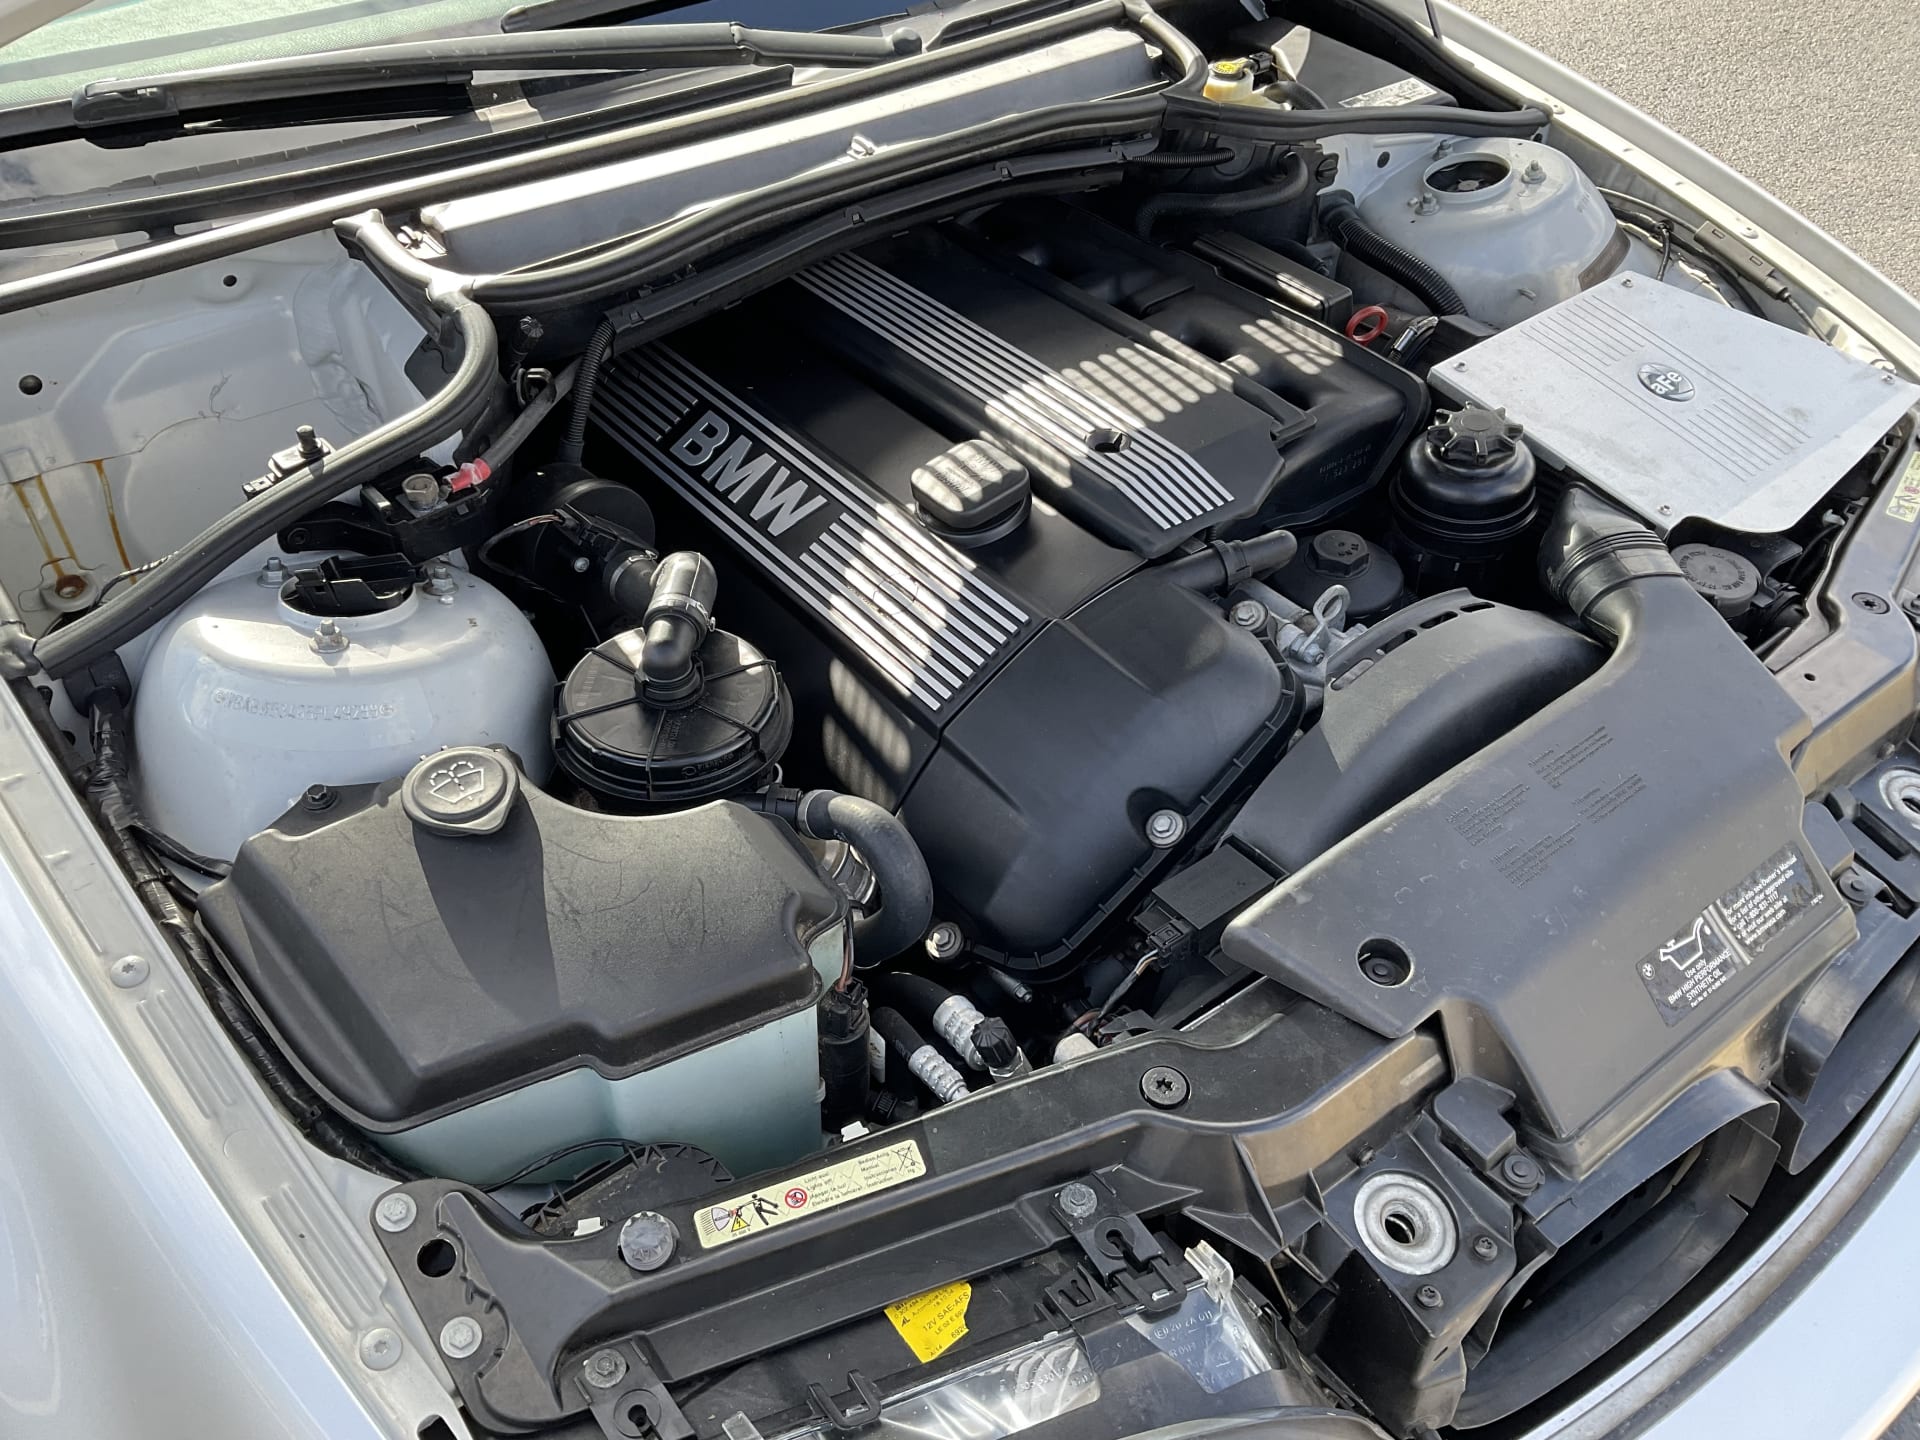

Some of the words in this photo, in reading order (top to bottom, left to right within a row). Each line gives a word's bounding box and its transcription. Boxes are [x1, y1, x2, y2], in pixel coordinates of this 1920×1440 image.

[1650, 371, 1683, 395] aFe
[669, 409, 828, 537] BMW
[1744, 890, 1755, 900] info
[1761, 869, 1781, 886] Owner's
[1779, 854, 1797, 871] Manual
[1764, 874, 1786, 896] approved
[1784, 869, 1794, 879] oils
[1668, 987, 1682, 1004] BMW
[1681, 977, 1696, 994] HIGH
[1694, 947, 1732, 983] PERFORMANCE
[1684, 966, 1696, 978] Use
[1696, 958, 1707, 971] only
[1686, 974, 1714, 1000] SYNTHETIC
[1712, 968, 1724, 979] OIL
[923, 1318, 937, 1332] 12V
[936, 1292, 970, 1320] SAE-AFS
